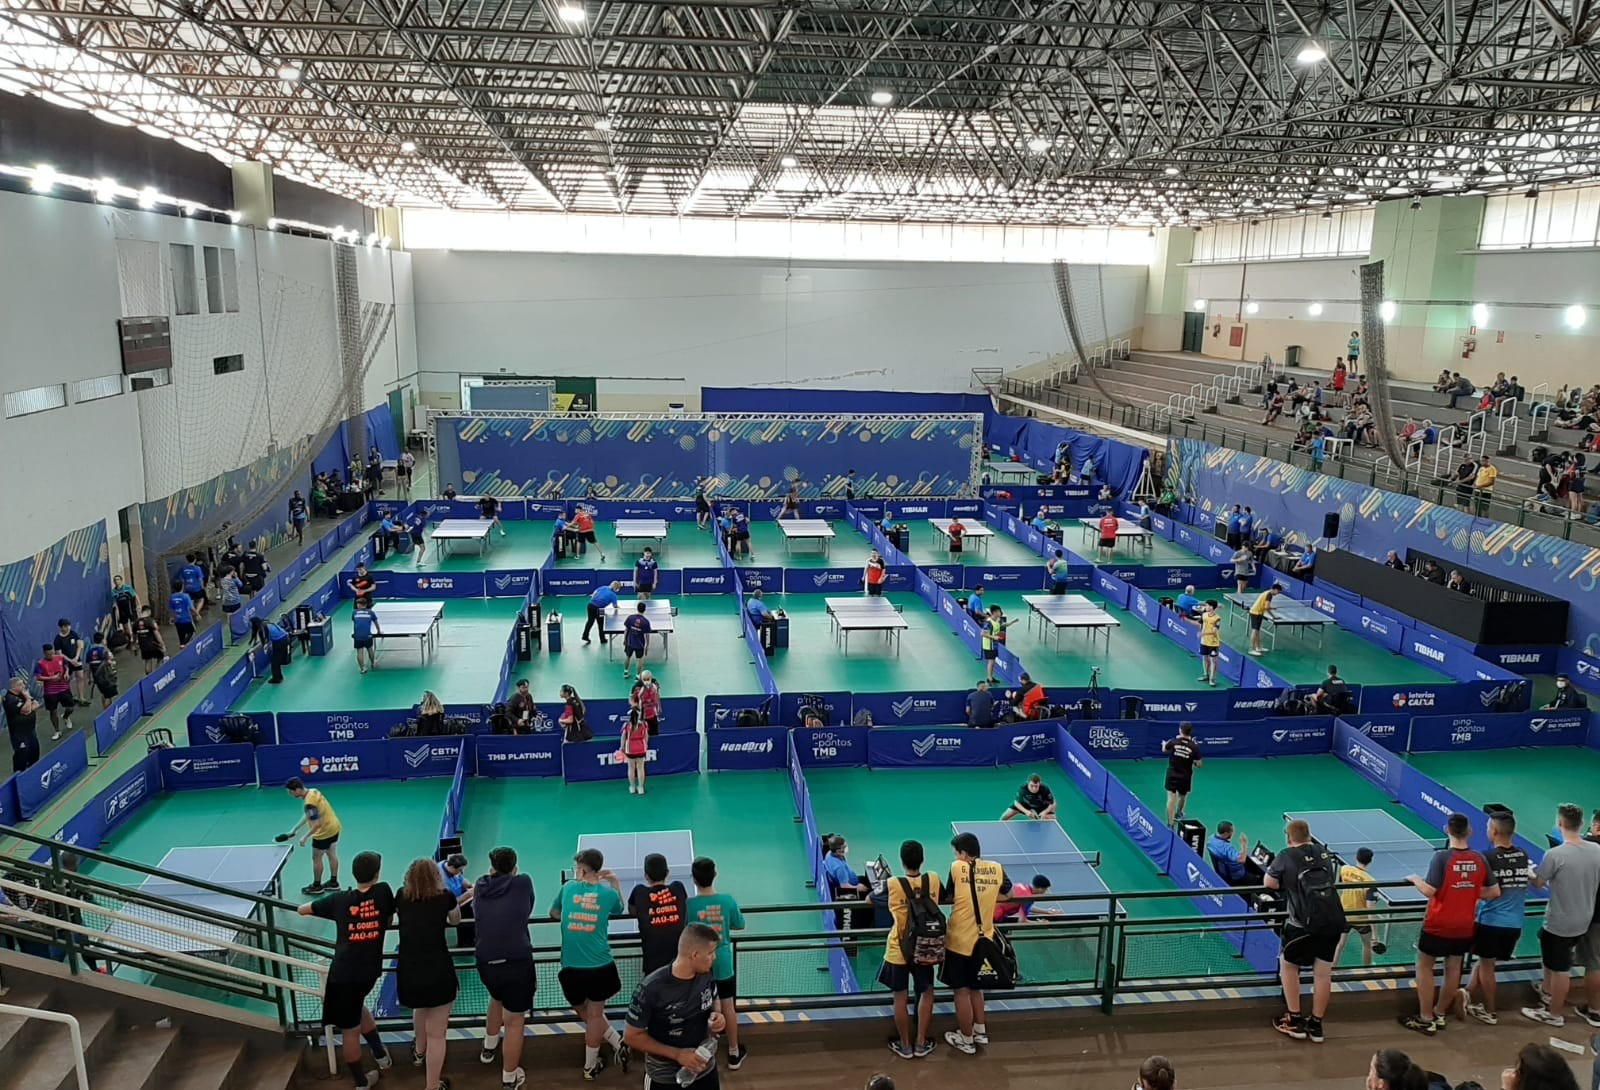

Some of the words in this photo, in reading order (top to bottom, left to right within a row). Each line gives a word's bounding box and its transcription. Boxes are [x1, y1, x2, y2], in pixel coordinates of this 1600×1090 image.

[1414, 642, 1445, 663] TIBHAR
[1500, 654, 1541, 663] TIBHAR
[1408, 698, 1435, 706] CAIXA
[1144, 703, 1182, 712] TIBHAR
[326, 713, 353, 724] ping-
[1371, 725, 1395, 733] CBTM
[328, 730, 355, 739] TMB
[812, 732, 837, 741] ping-
[1451, 733, 1472, 741] TMB
[936, 738, 961, 746] CBTM
[431, 747, 459, 756] CBTM
[508, 752, 552, 760] PLATINUM
[812, 748, 837, 757] TMB
[322, 755, 359, 763] loterias
[322, 763, 359, 772] CAIXA
